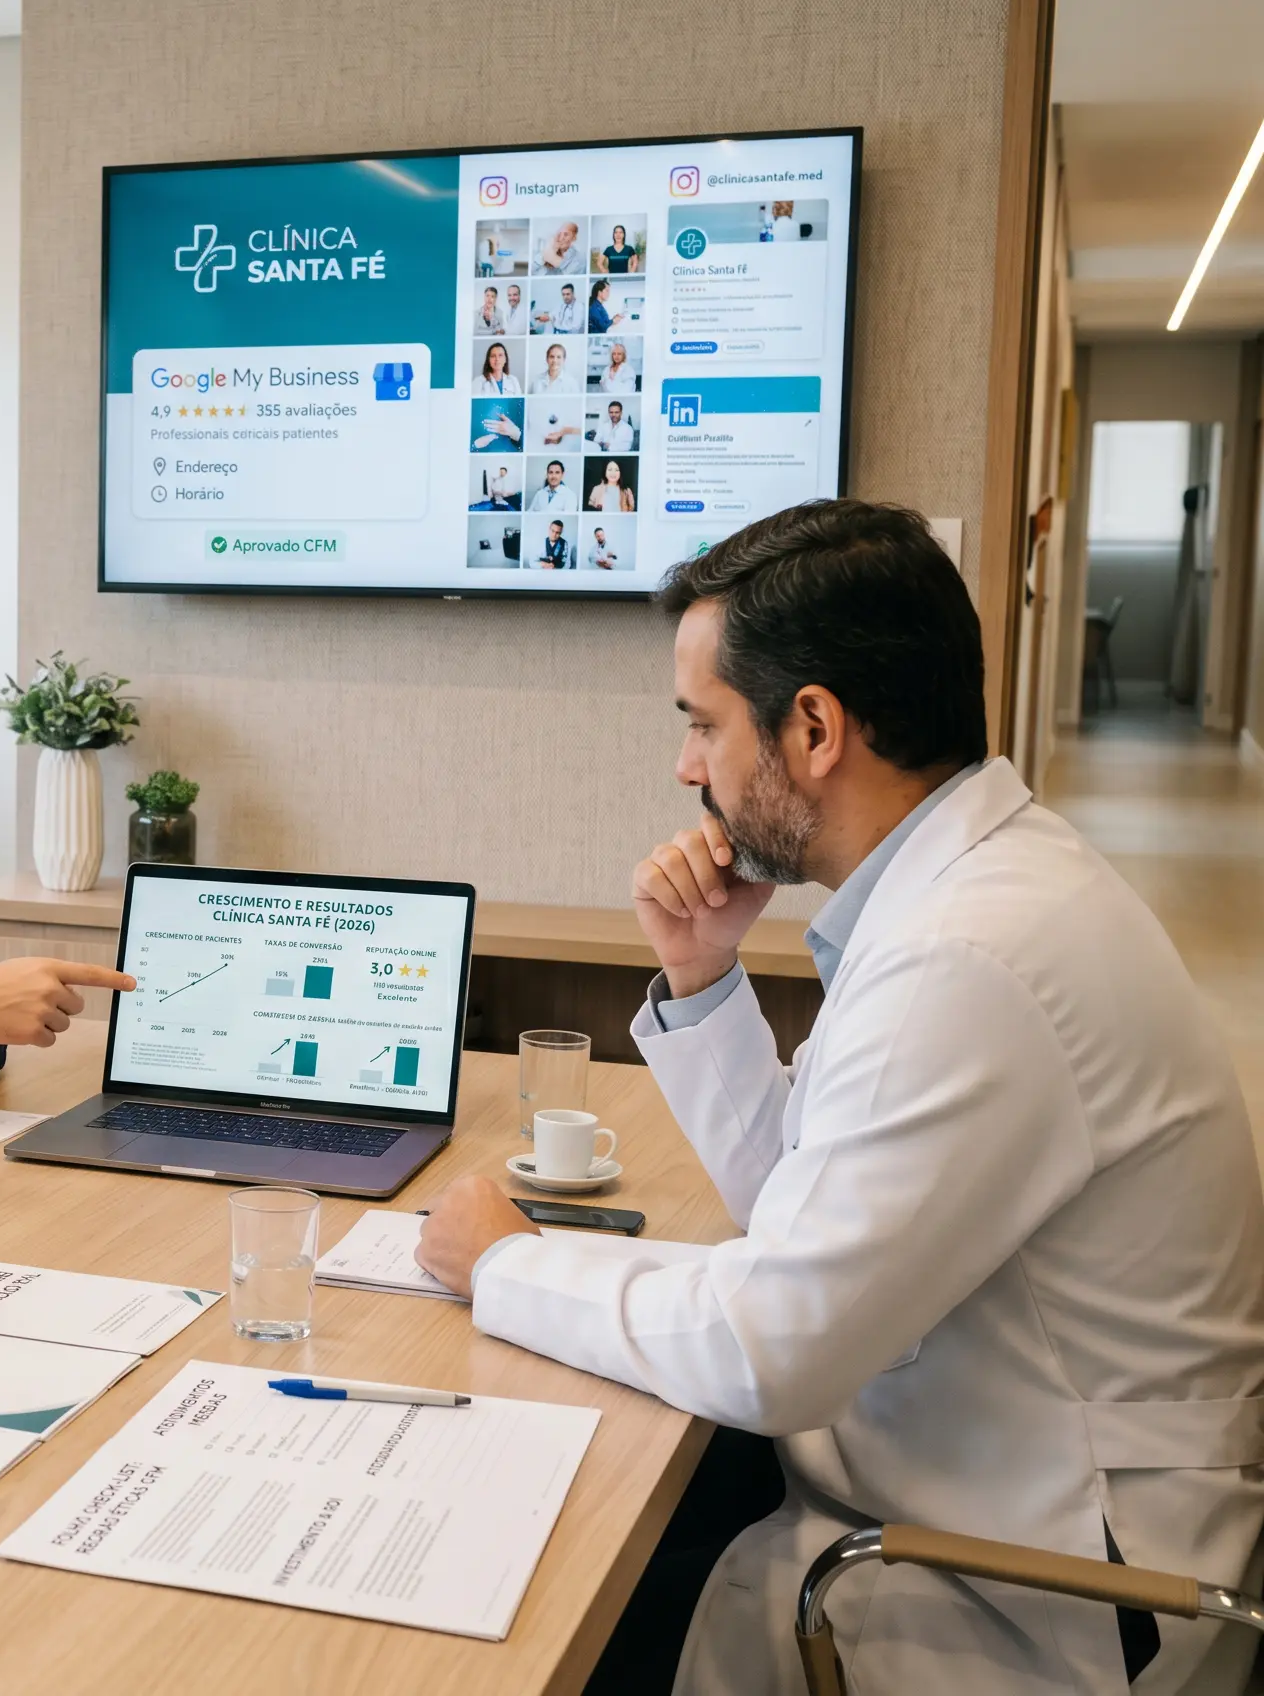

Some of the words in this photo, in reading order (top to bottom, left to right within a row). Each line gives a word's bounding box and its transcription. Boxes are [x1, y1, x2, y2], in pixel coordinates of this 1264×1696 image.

[707, 170, 823, 187] @clinicasantafe.med
[515, 181, 580, 197] Instagram
[247, 224, 359, 252] CLÍNICA
[247, 257, 343, 283] SANTA
[351, 250, 386, 280] FÉ
[708, 264, 735, 275] Santa
[151, 368, 227, 393] Google
[233, 367, 263, 392] My
[269, 366, 360, 387] Business
[151, 405, 171, 419] 4,9
[256, 404, 281, 417] 355
[285, 403, 357, 420] avaliações
[673, 400, 695, 423] in
[150, 428, 229, 440] Professionais
[282, 428, 338, 442] patientes
[176, 460, 238, 477] Endereço
[176, 486, 225, 501] Horário
[232, 538, 300, 555] Aprovado
[303, 538, 337, 553] CFM
[198, 894, 291, 910] CRESCIMENTO
[295, 900, 303, 911] E
[307, 900, 394, 916] RESULTADOS
[213, 908, 265, 924] CLÍNICA
[268, 914, 311, 928] SANTA
[315, 915, 331, 929] FÉ
[334, 918, 375, 935] (2026)
[145, 931, 193, 941] CRESCIMENTO
[205, 935, 243, 944] PACIENTES
[264, 939, 287, 947] TAXAS
[299, 941, 343, 951] CONVERSÃO
[365, 946, 409, 957] REPUTAÇÃO
[410, 949, 437, 958] ONLINE
[369, 962, 394, 977] 3,0
[377, 992, 418, 1003] Excelente
